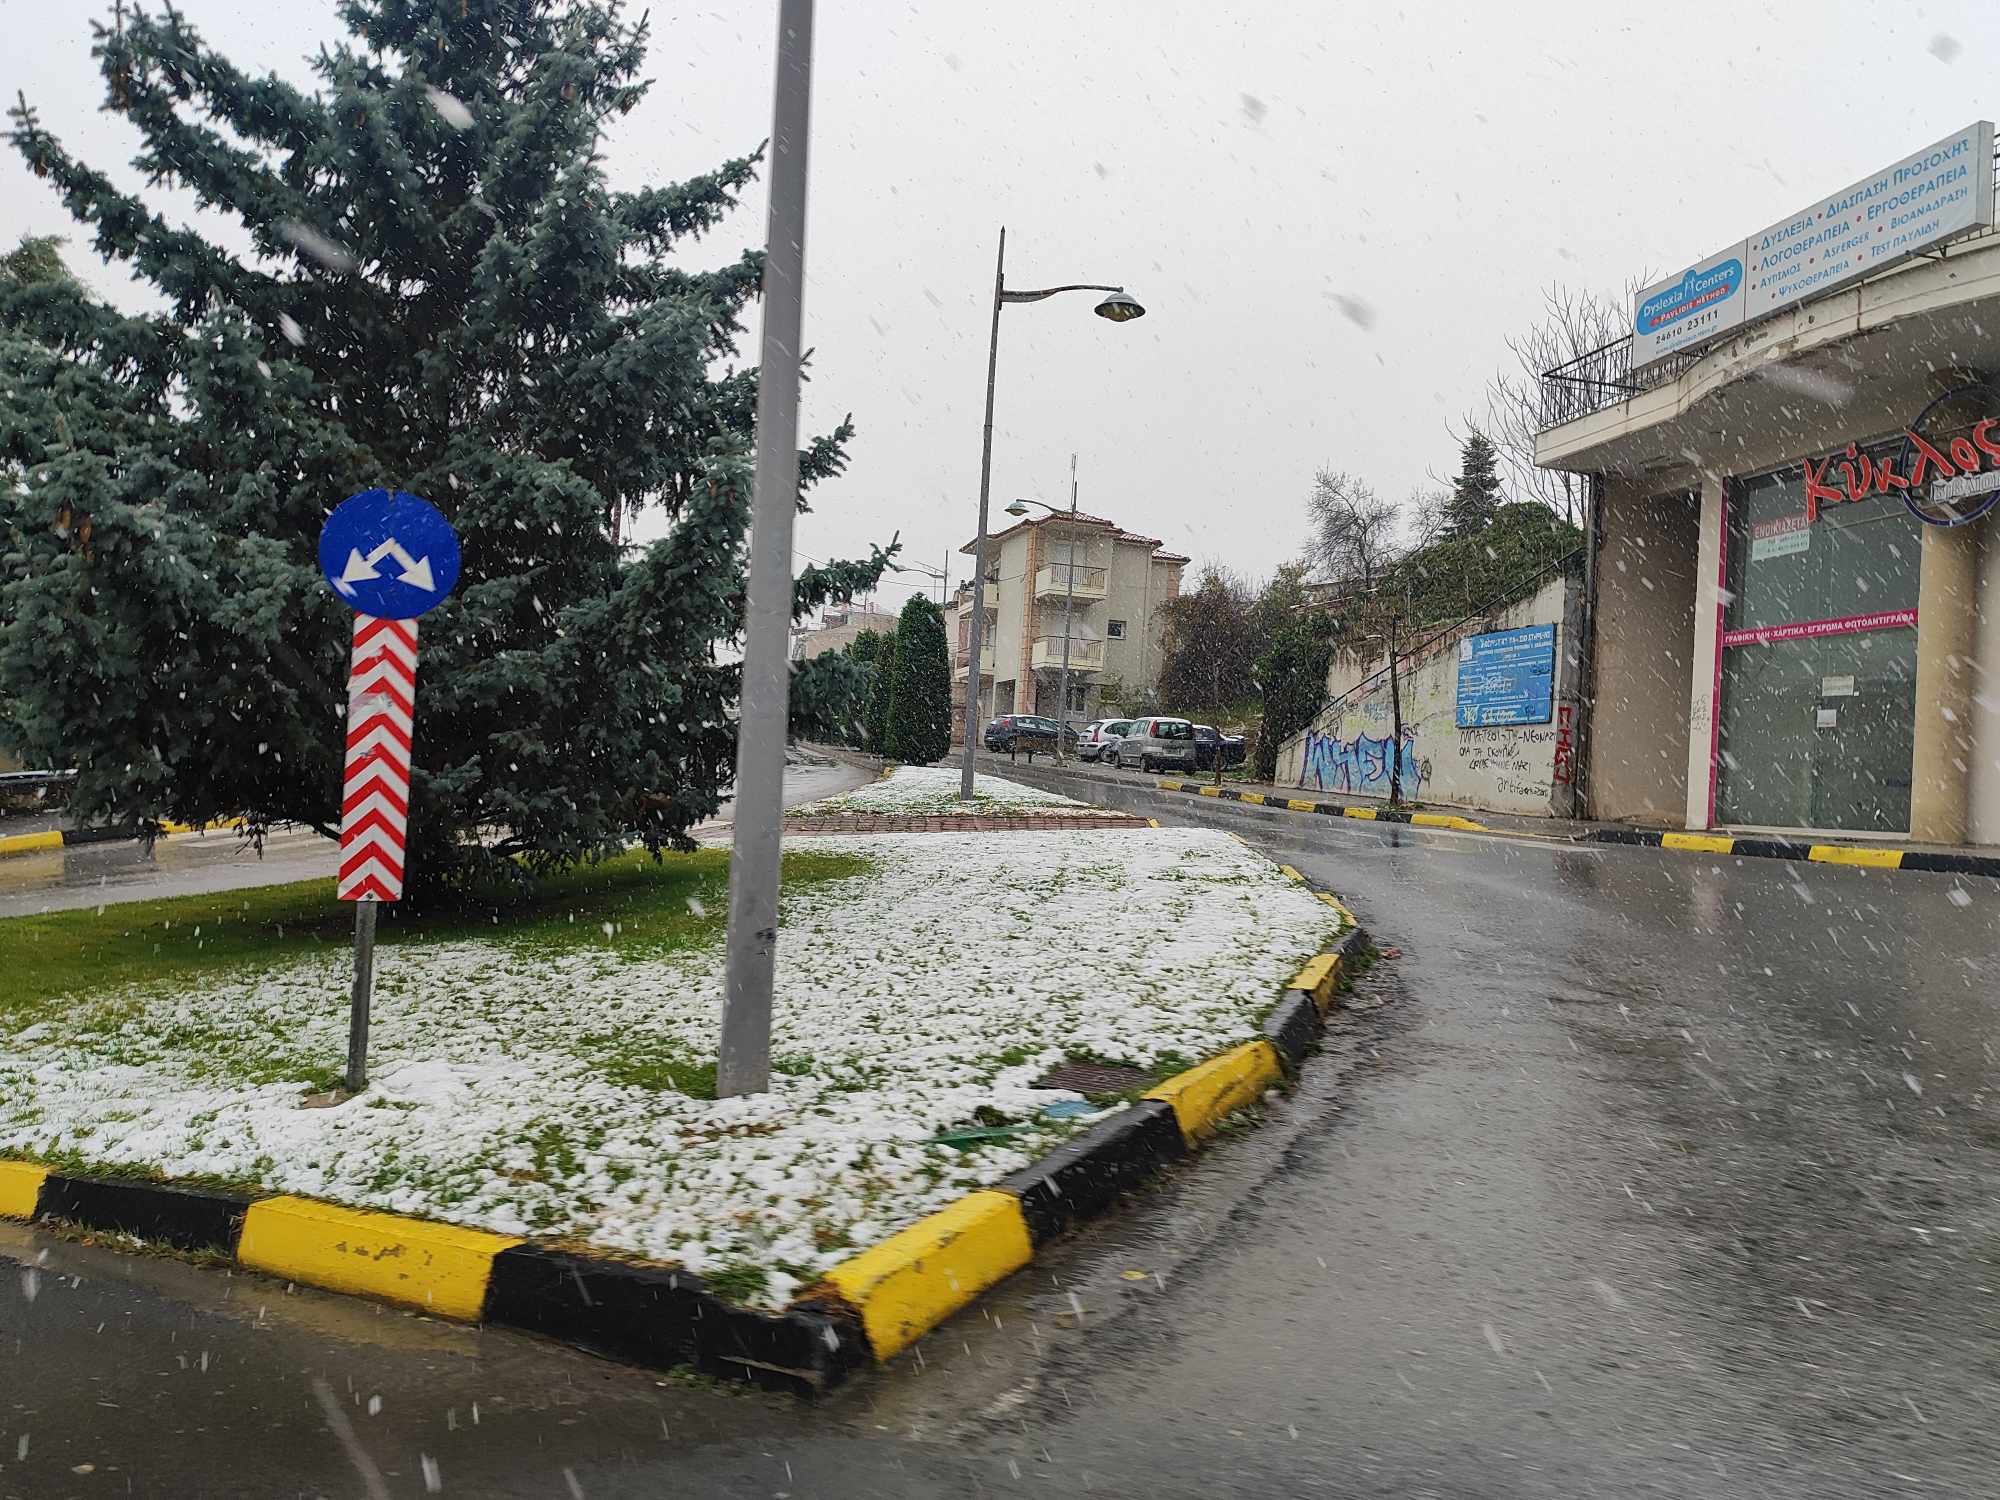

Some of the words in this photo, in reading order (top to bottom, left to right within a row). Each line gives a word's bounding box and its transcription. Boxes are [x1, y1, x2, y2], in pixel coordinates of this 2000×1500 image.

[1761, 217, 1814, 251] ΔΥΣΛΕΞΙΑ
[1826, 178, 1889, 219] ΔΙΑΣΠΑΣΗ
[1893, 138, 1969, 186] ΠΡΟΣΟΧΗΣ
[1890, 186, 1968, 230] ΒΙΟΑΝΑΔΡΑΣΗ
[1761, 221, 1850, 272] ΛΟΓΟΘΕΡΑΠΕΙΑ
[1867, 164, 1968, 220] ΕΡΓΟΘΕΡΑΠΕΙΑ
[1643, 291, 1683, 317] Dyslexia
[1695, 266, 1734, 292] Centers
[1779, 260, 1850, 297] ΨΥΧΟΘΕΡΑΠΕΙΑ
[1656, 327, 1682, 344] 24610
[1687, 309, 1718, 331] 23111
[1725, 632, 1755, 643] ΓΡΑΦΙΚΗ
[1773, 626, 1804, 638] ΧΑΡΤΙΚΑ
[1807, 622, 1843, 633] ΕΓΧΡΩΜΑ
[1844, 613, 1915, 629] ΦΩΤΟΑΝΤΙΓΡΑΦΑ
